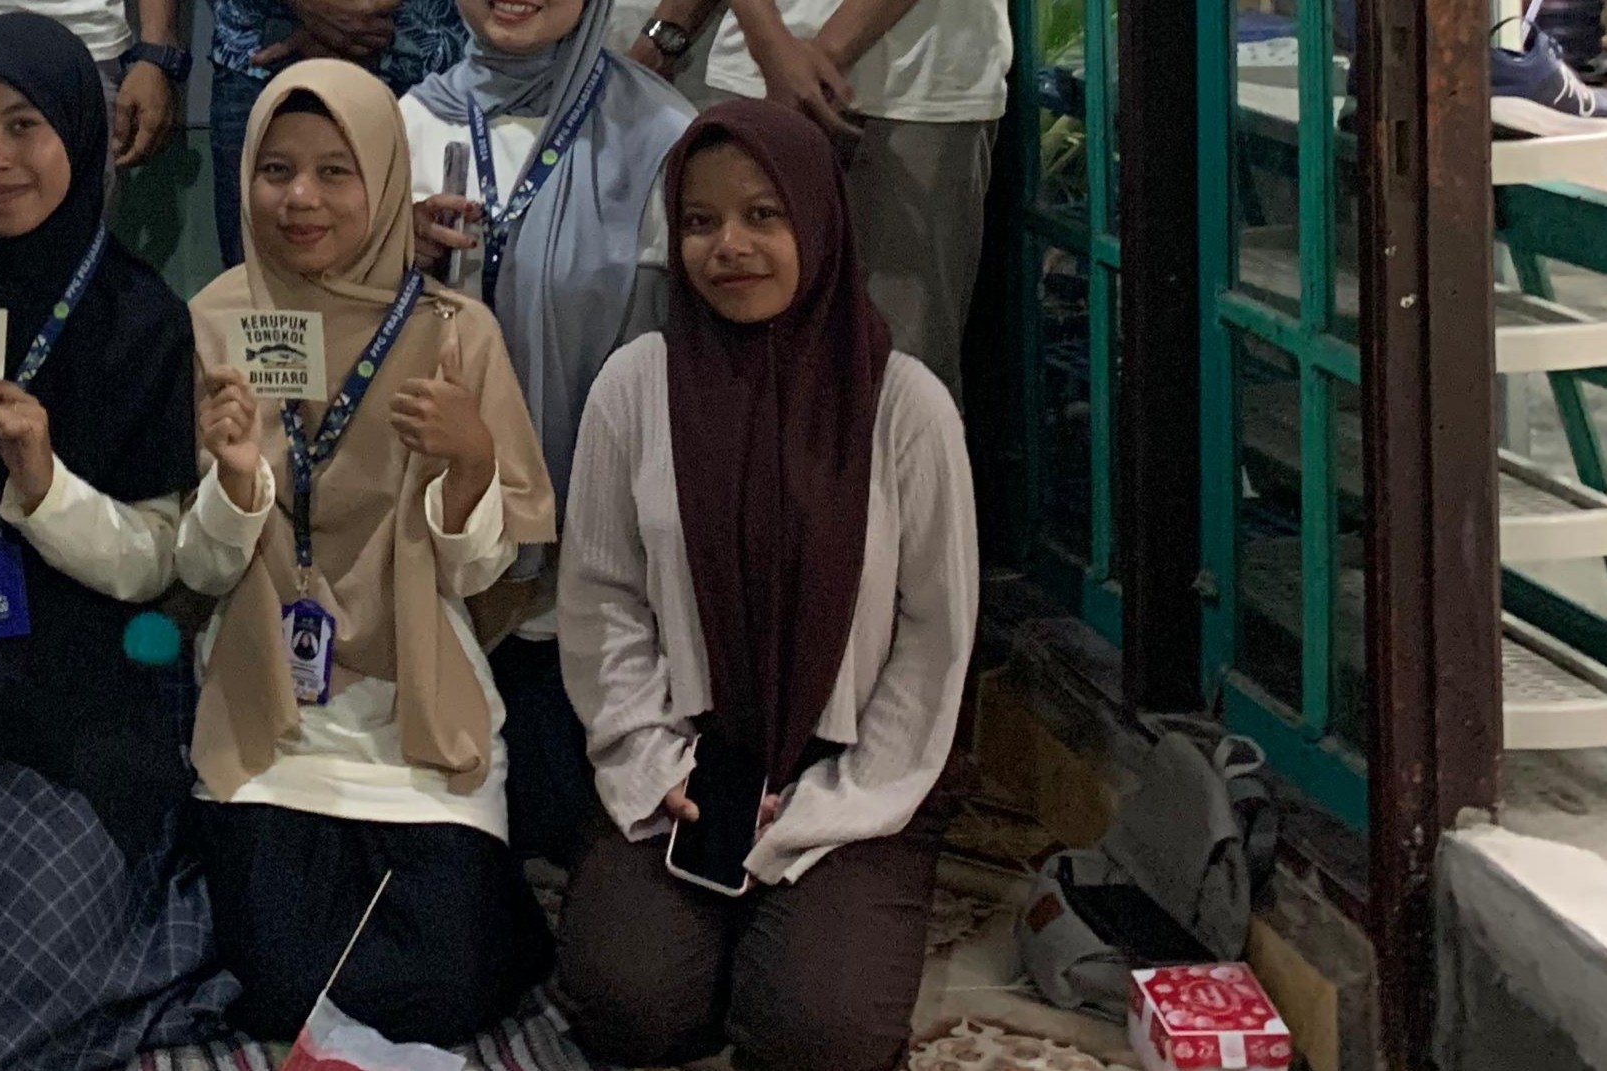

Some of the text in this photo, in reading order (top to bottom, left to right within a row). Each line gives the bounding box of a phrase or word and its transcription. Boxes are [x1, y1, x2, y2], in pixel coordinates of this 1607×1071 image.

[240, 314, 309, 331] KERUPUK
[369, 274, 420, 358] PPG PRAJABATAN
[246, 329, 306, 345] TONGKOL
[249, 371, 309, 385] BINTARO
